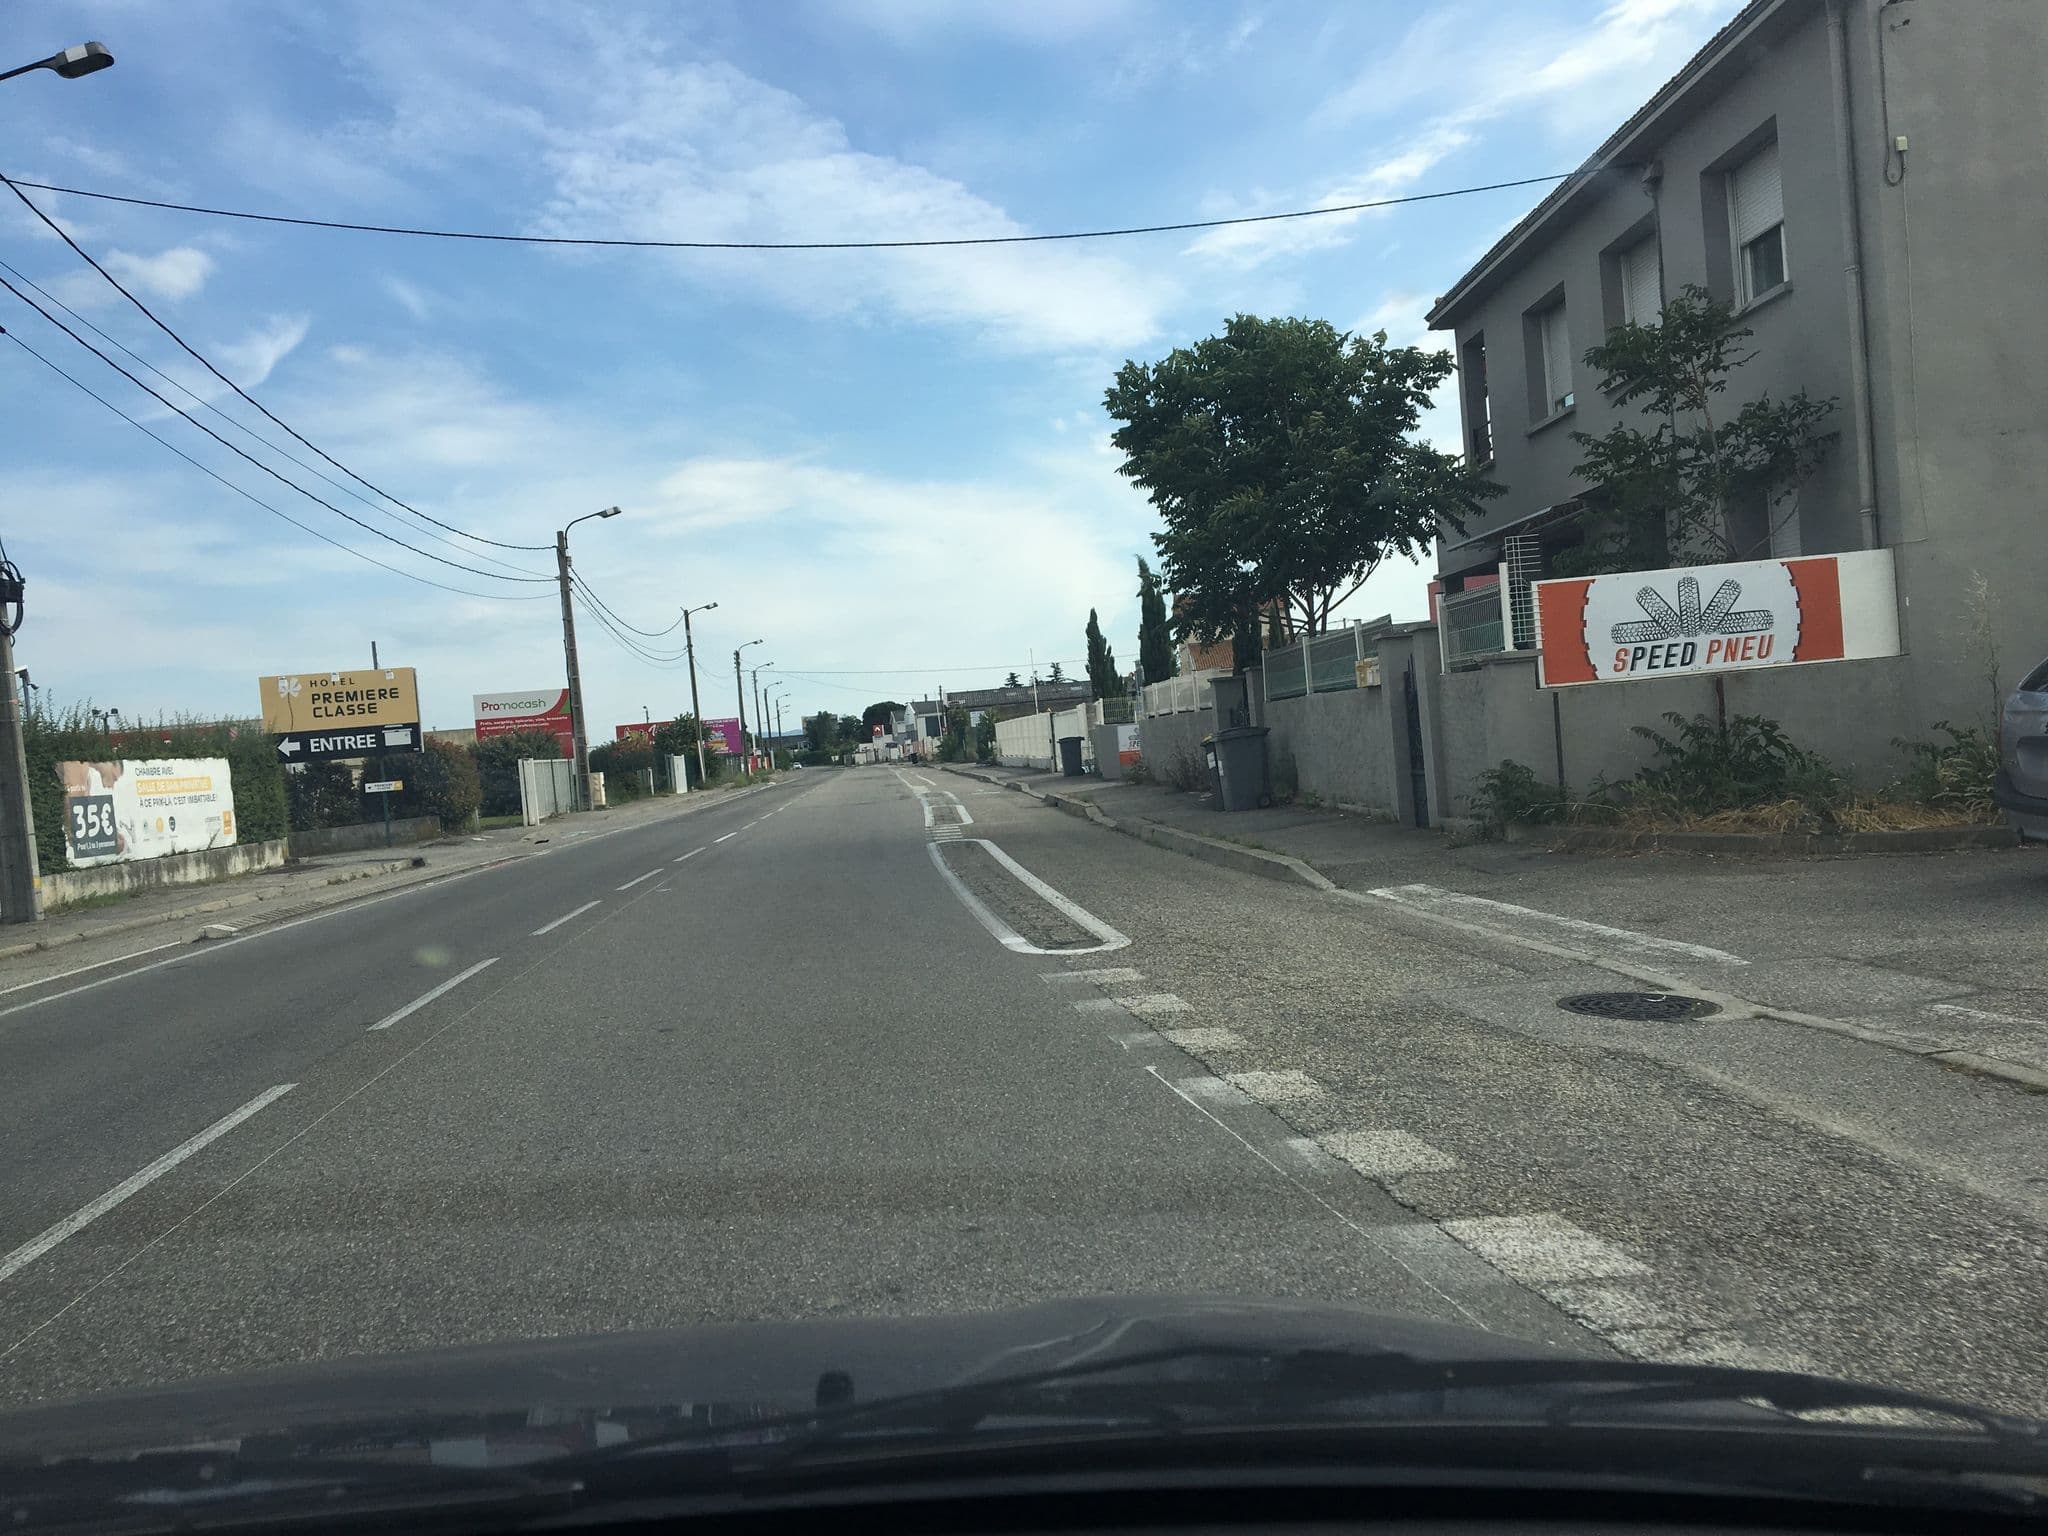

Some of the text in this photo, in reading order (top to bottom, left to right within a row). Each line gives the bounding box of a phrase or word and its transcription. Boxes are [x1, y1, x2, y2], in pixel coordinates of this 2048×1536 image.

[1613, 634, 1775, 673] SPEED PNEU
[311, 687, 400, 705] PREMIERE
[481, 698, 546, 712] Promocash
[313, 702, 378, 718] CLASSE
[309, 733, 377, 753] ENTREE
[72, 803, 114, 839] 35€
